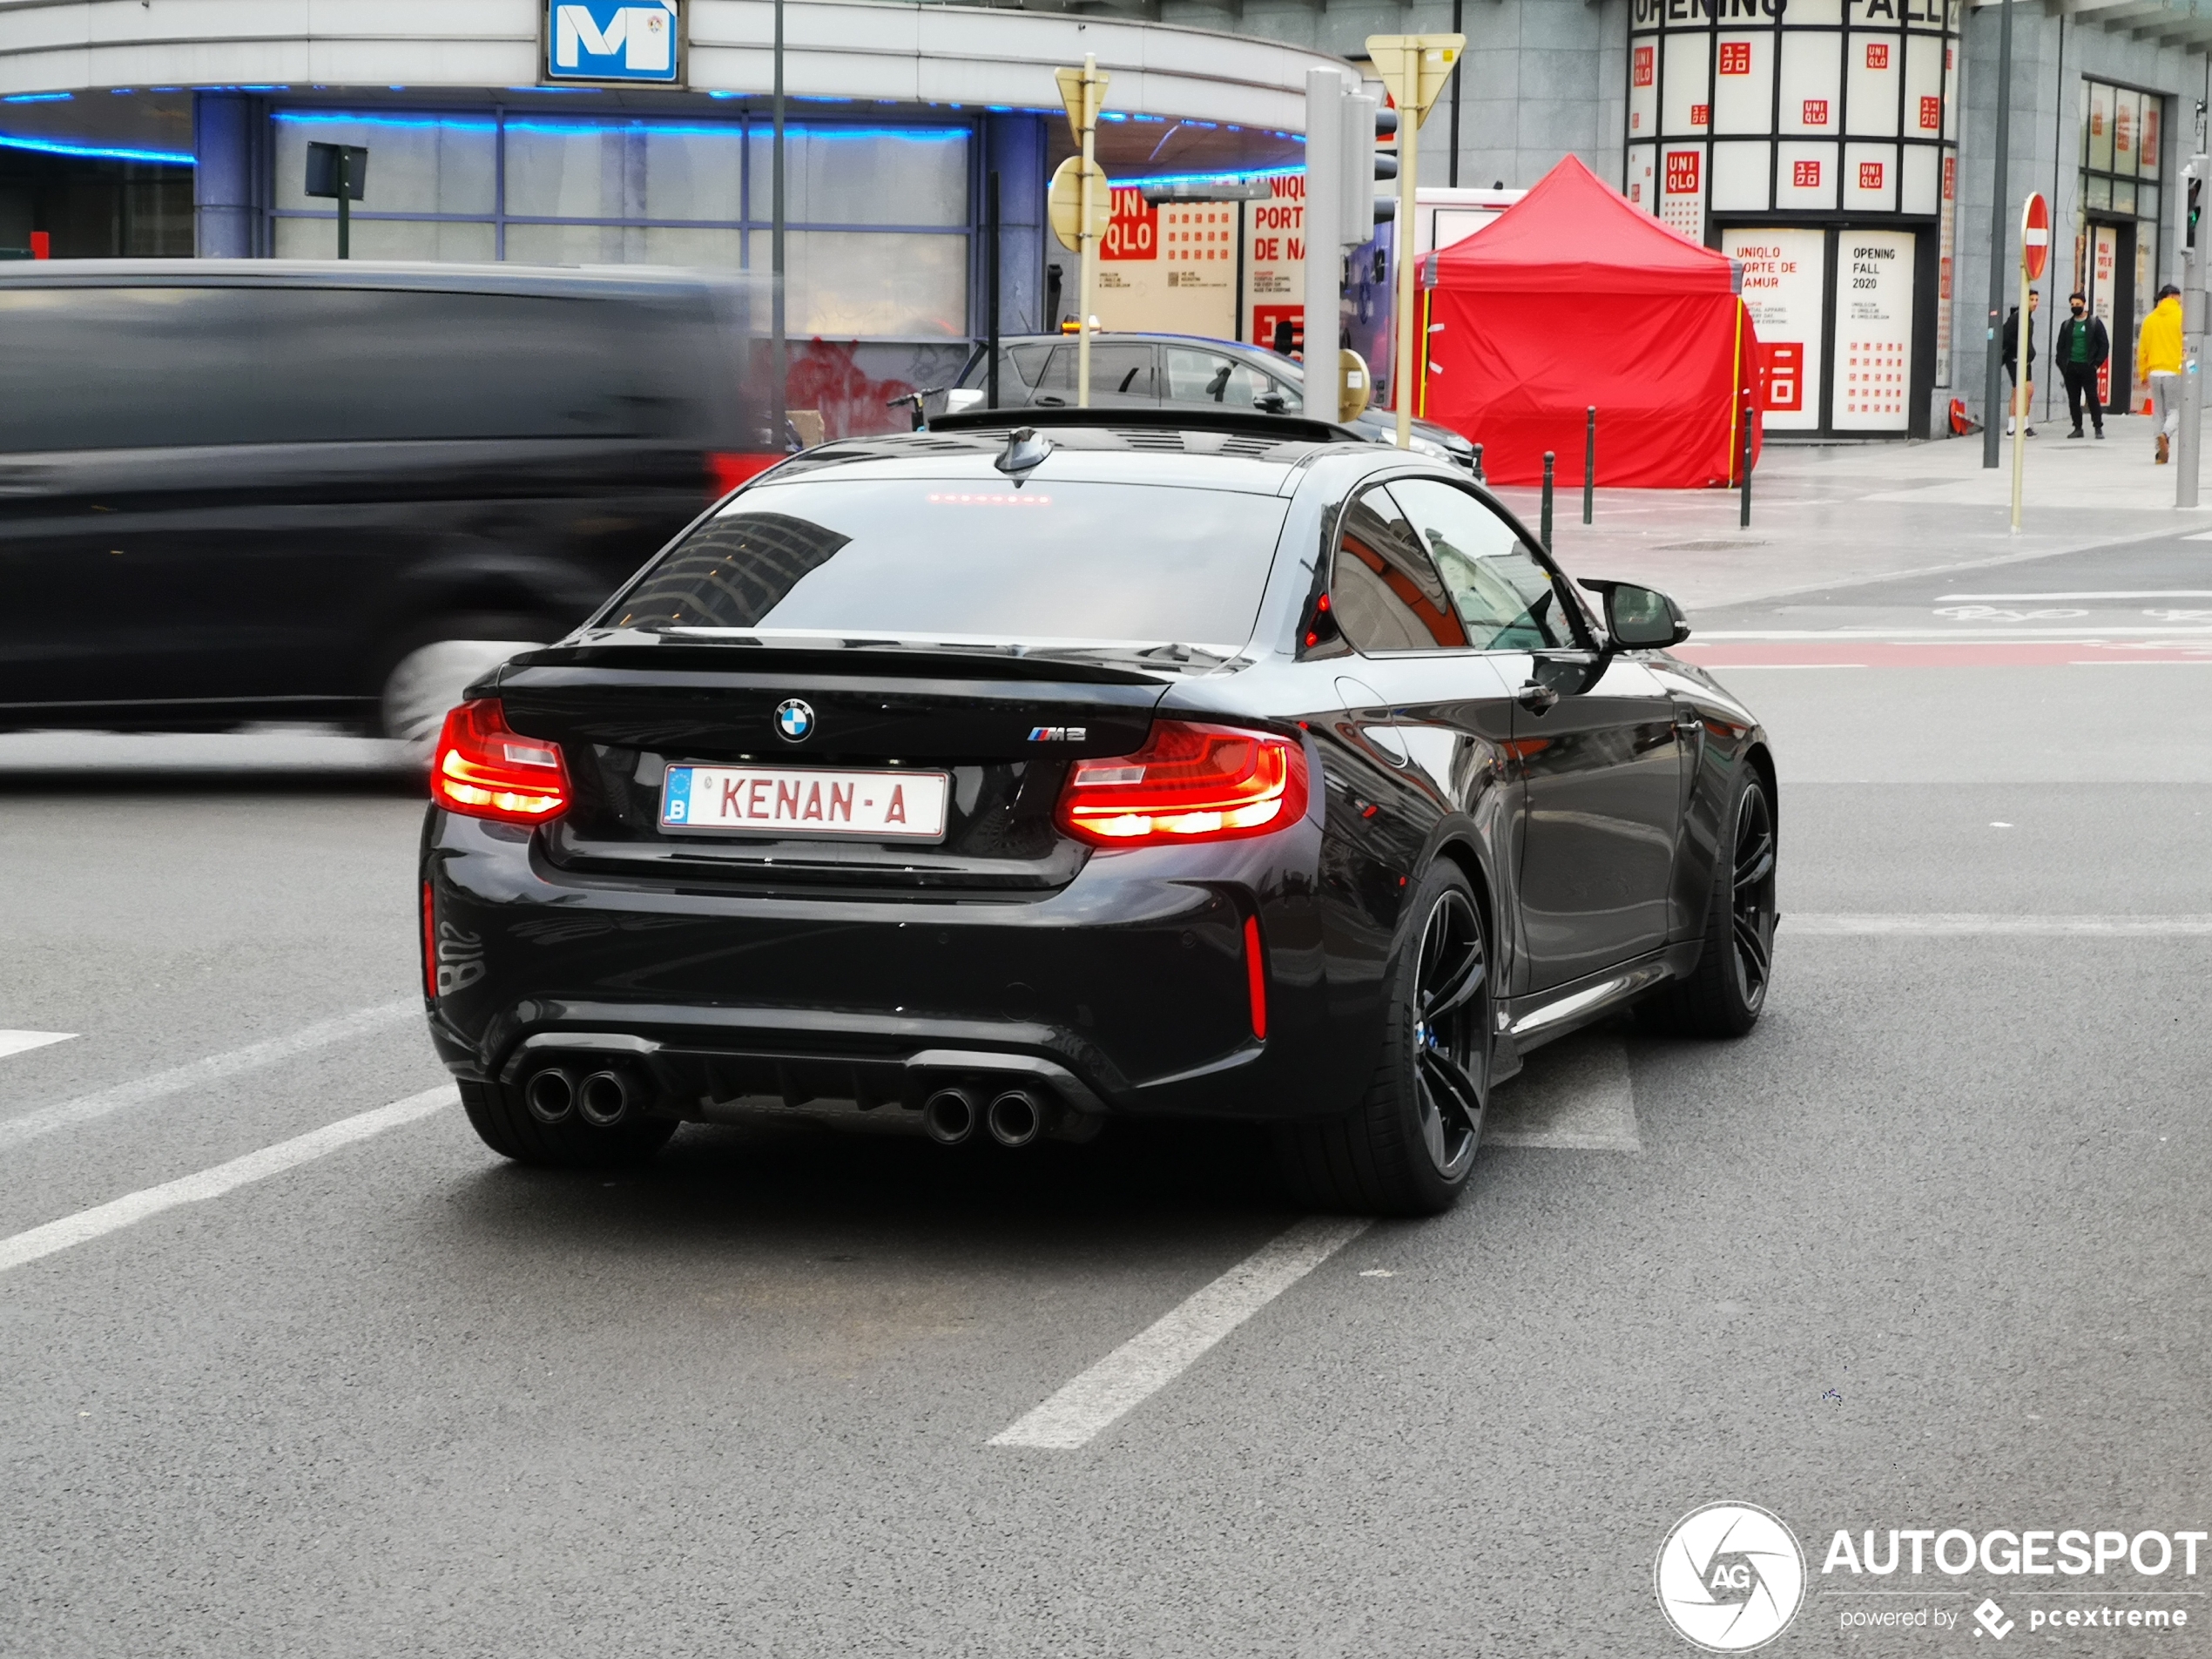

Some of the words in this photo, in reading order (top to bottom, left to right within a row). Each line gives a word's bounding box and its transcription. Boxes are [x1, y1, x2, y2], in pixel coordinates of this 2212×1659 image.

[556, 5, 669, 70] M
[1869, 46, 1885, 56] UNI
[1635, 51, 1649, 65] UNI
[1868, 57, 1885, 67] QLO
[1635, 68, 1650, 84] QLO
[1805, 102, 1824, 111] UNI
[1804, 112, 1825, 123] QLO
[1669, 156, 1693, 172] UNI
[1862, 165, 1879, 175] UNI
[1669, 173, 1695, 192] QLO
[1861, 177, 1880, 187] QLO
[1256, 206, 1305, 229] PORT
[1106, 222, 1151, 255] QLO
[1737, 246, 1781, 260] UNIQLO
[1853, 247, 1896, 260] OPENING
[1743, 261, 1776, 273] ORTE
[1781, 261, 1797, 273] DE
[1852, 262, 1880, 274] FALL
[1743, 277, 1779, 288] AMUR
[1852, 278, 1877, 289] 2020
[670, 799, 685, 819] B
